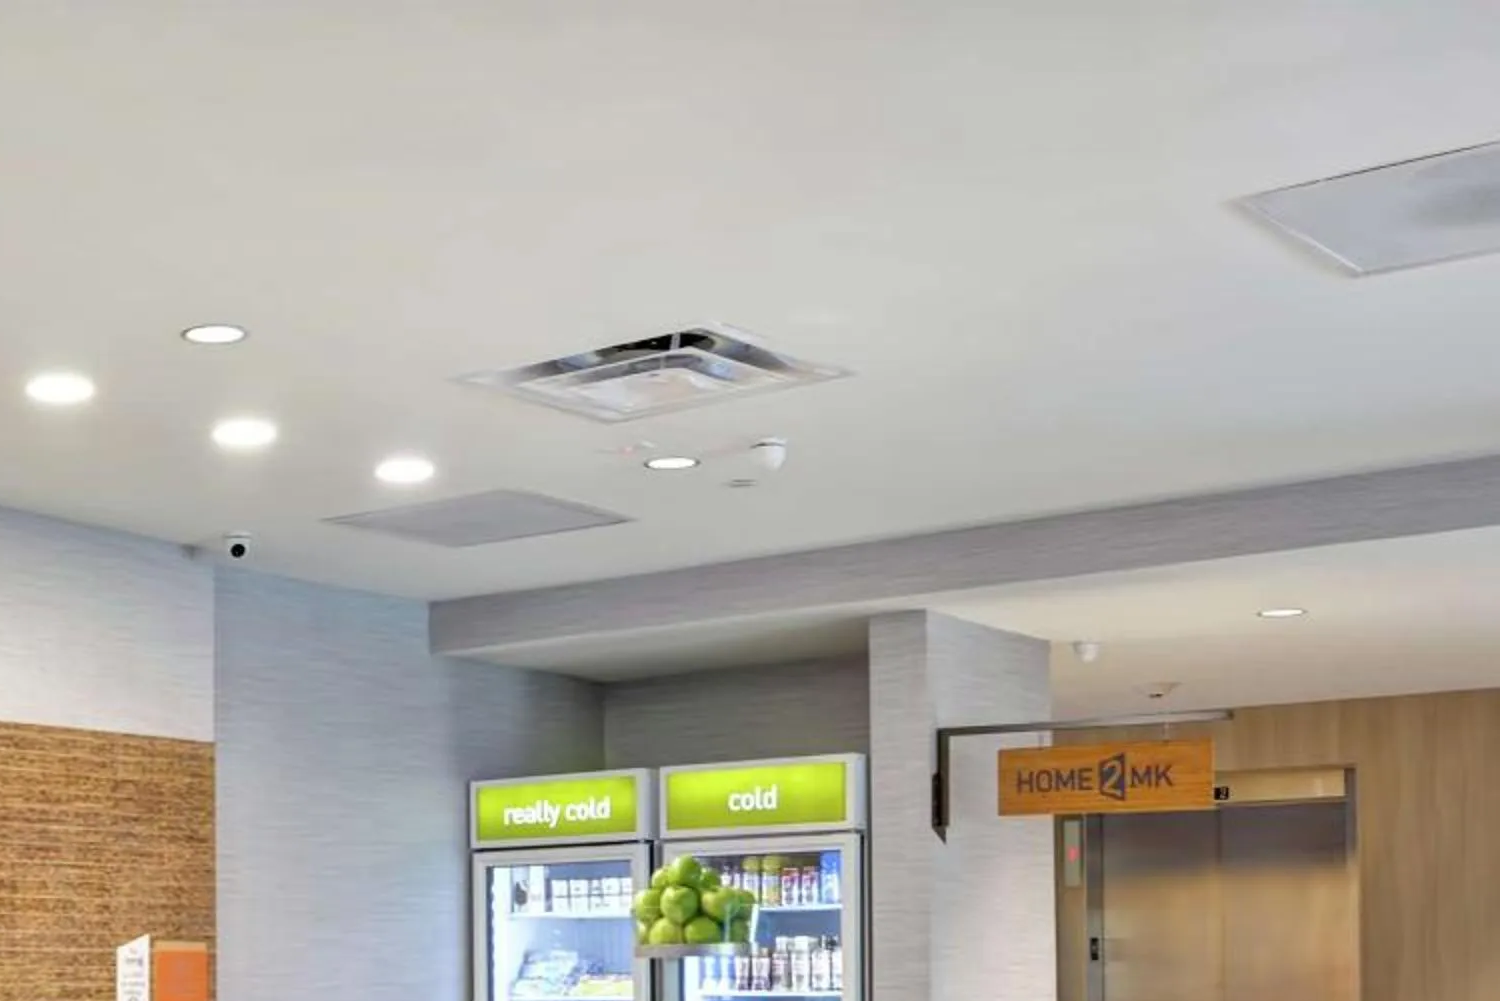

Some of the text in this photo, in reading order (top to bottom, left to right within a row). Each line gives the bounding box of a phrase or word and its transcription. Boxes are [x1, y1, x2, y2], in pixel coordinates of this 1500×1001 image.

[503, 796, 611, 828] really cold
[728, 784, 778, 811] cold
